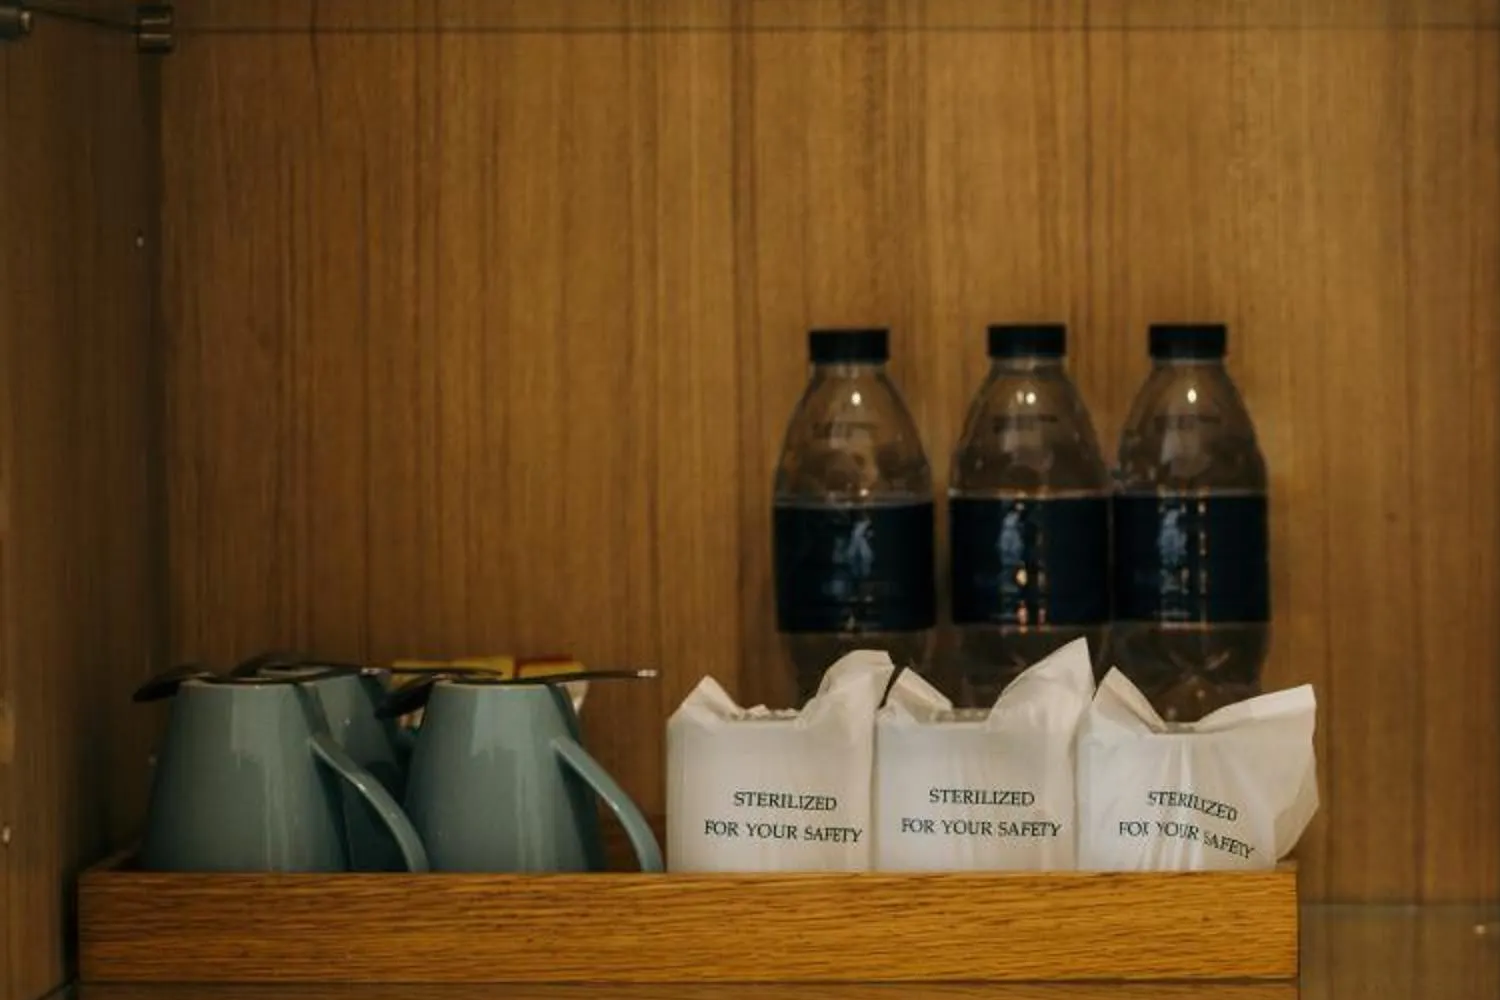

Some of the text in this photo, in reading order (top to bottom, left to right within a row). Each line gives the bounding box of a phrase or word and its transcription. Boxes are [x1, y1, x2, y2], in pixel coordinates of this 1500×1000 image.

[733, 791, 837, 811] STERILIZED
[929, 788, 1035, 806] STERILIZED
[1147, 791, 1238, 821] STERILIZED
[704, 819, 863, 843] FOR YOUR SAFETY
[901, 817, 1062, 837] FOR YOUR SAFETY
[1203, 829, 1255, 859] SAFETY
